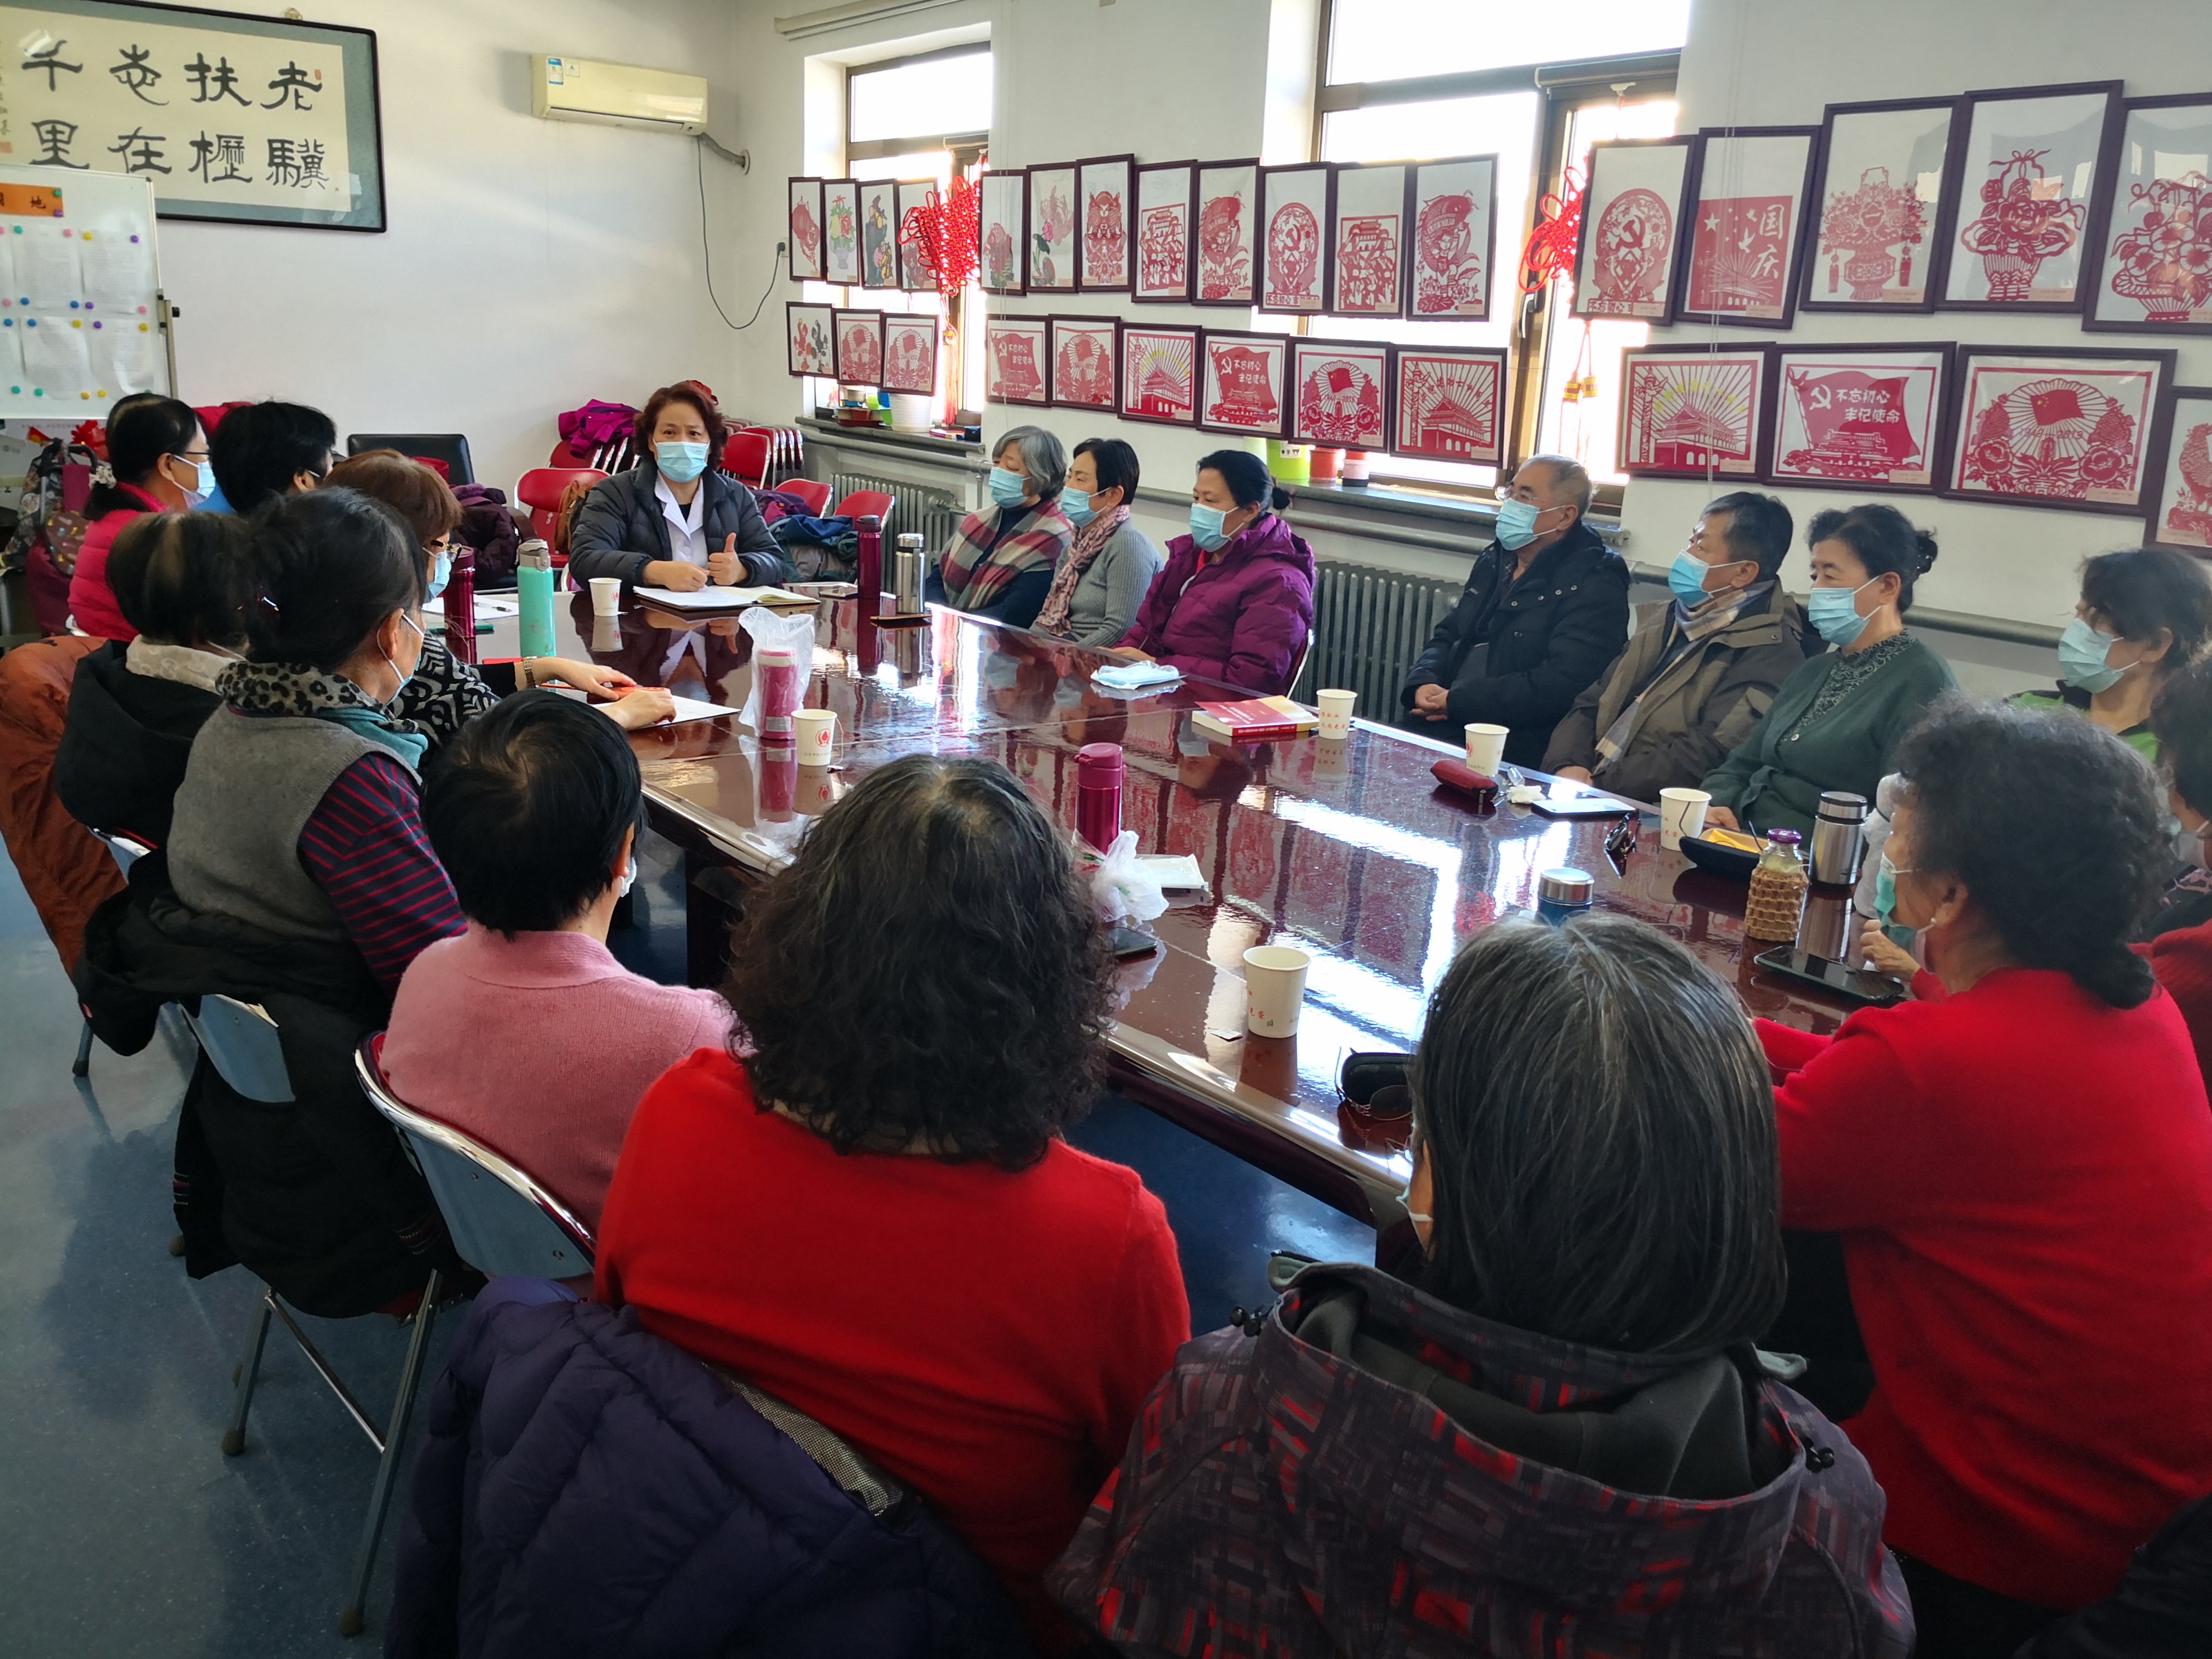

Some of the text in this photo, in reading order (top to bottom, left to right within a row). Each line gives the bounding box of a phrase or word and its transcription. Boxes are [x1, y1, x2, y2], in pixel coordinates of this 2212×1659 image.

[1750, 204, 1784, 279] 国庆
[1234, 360, 1262, 371] 不忘初心
[1238, 372, 1267, 385] 牢记使命
[1836, 389, 1891, 404] 不忘初心
[1845, 407, 1900, 424] 牢记使命
